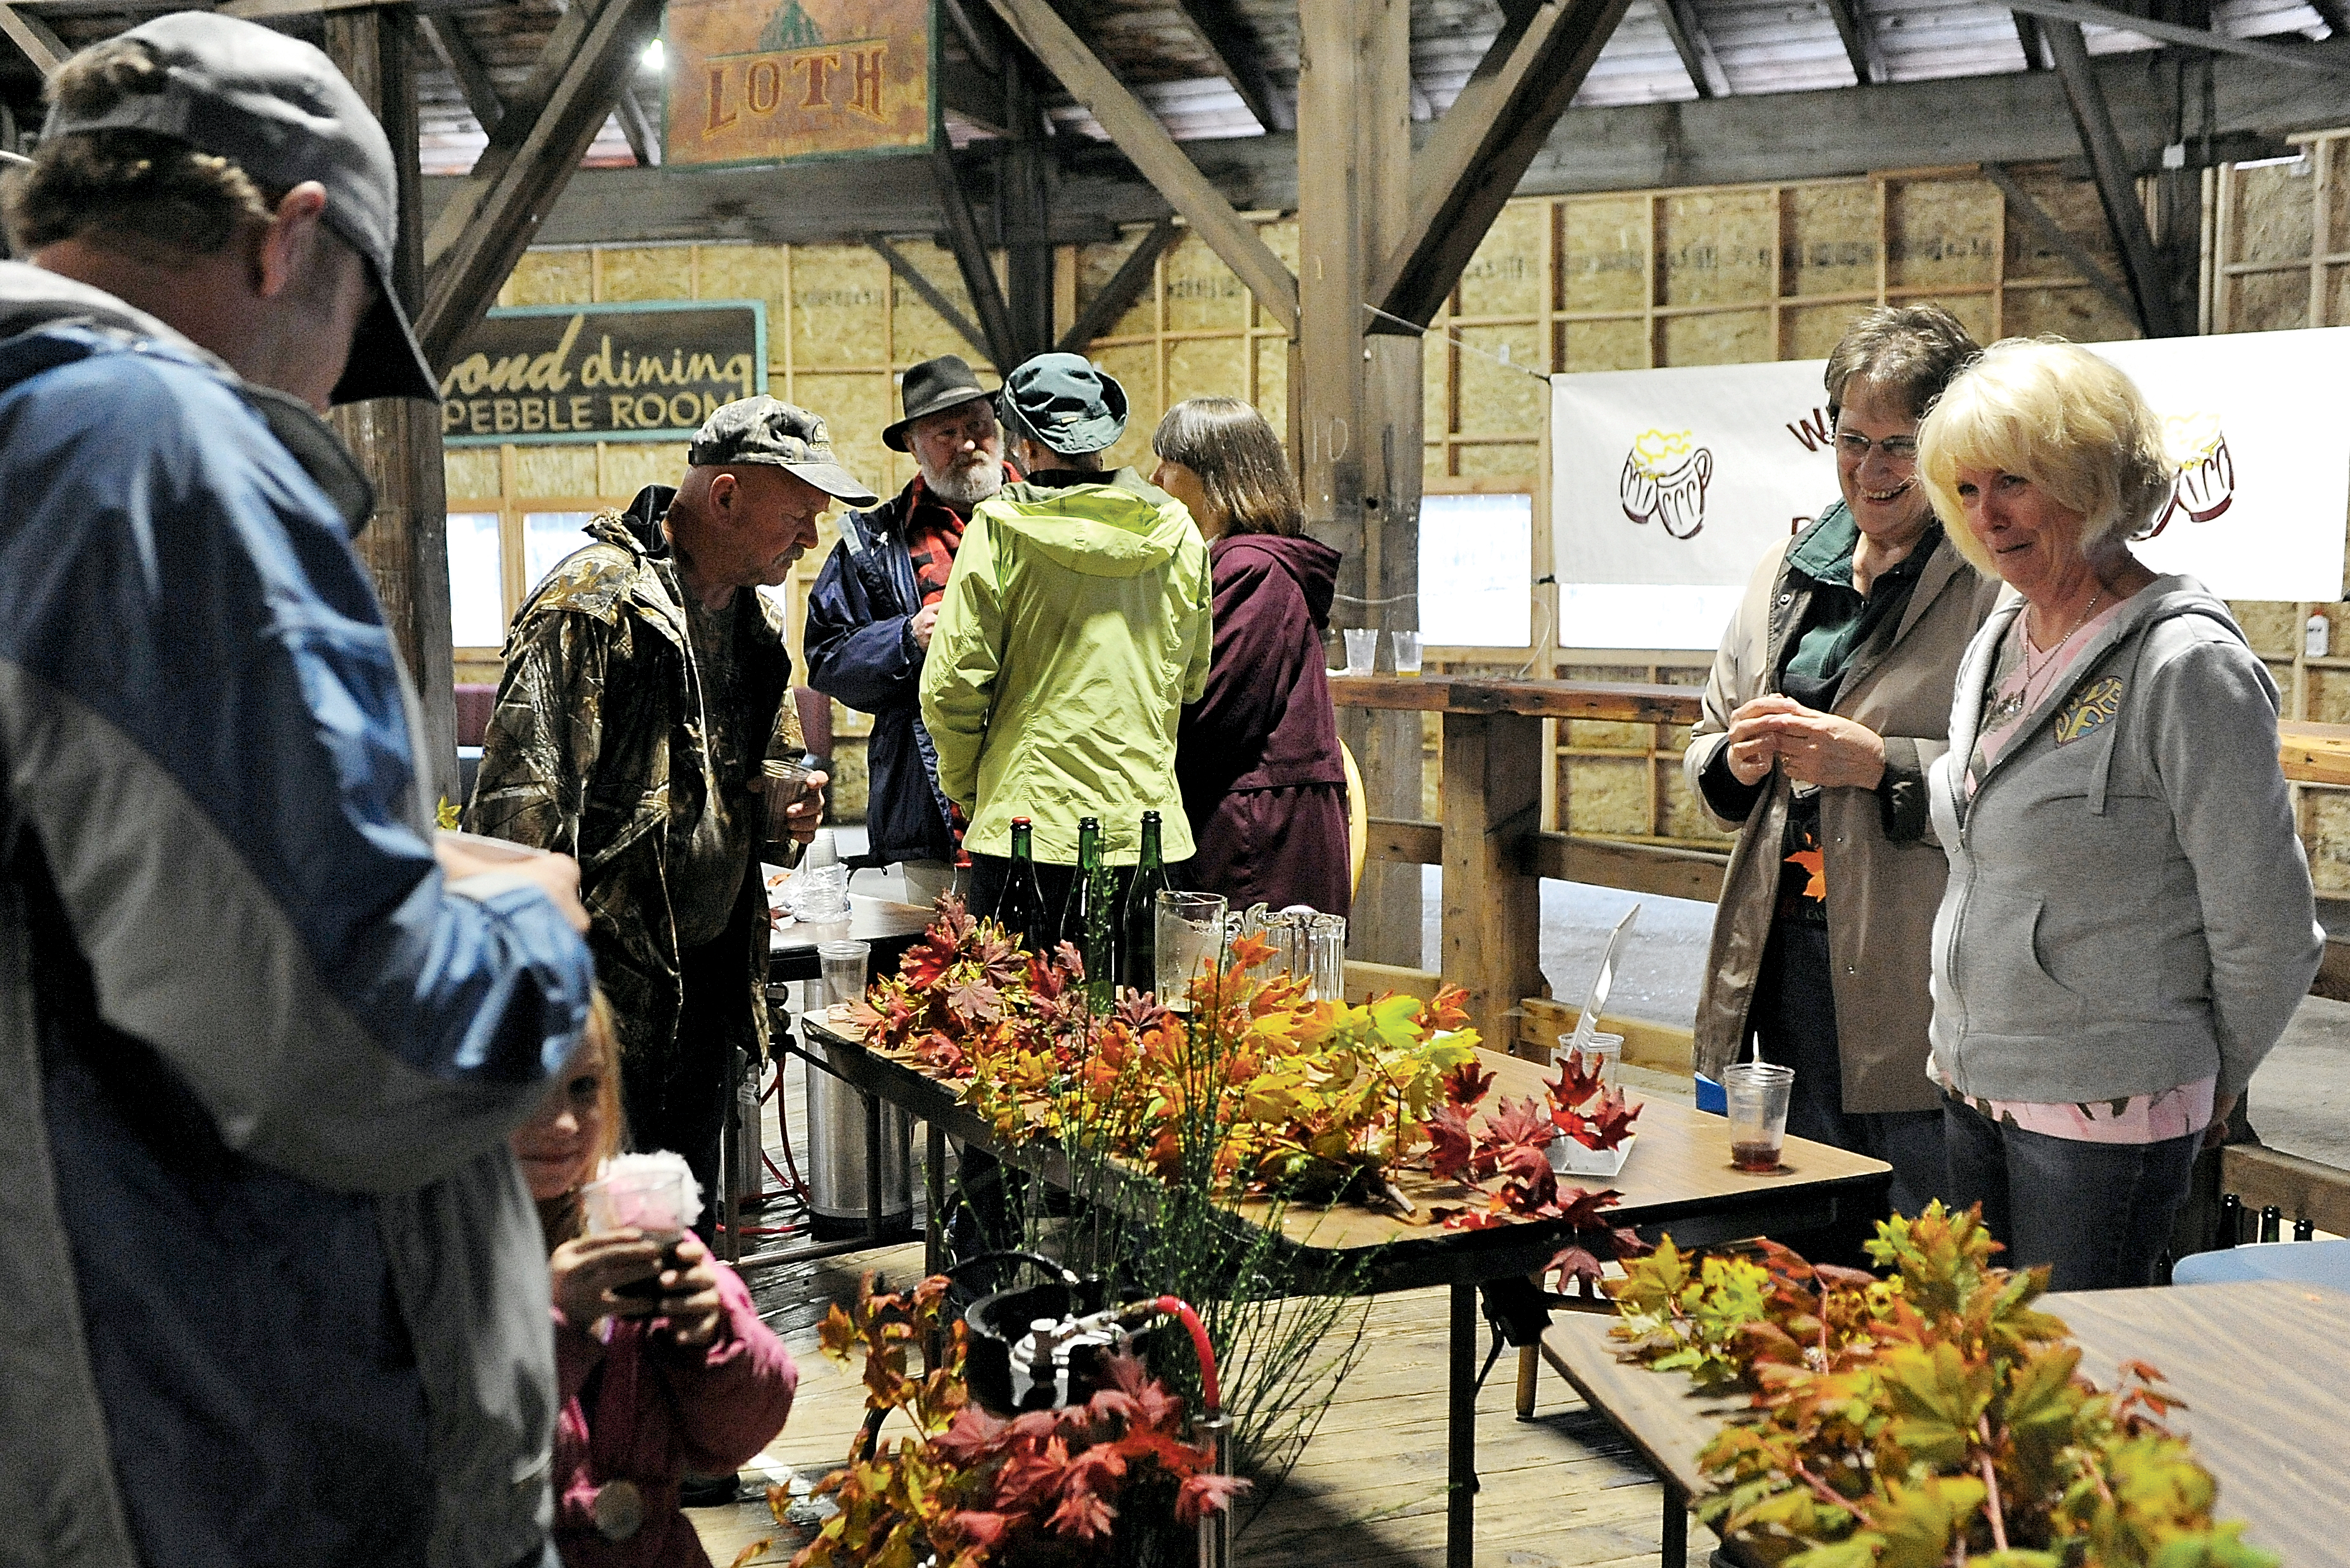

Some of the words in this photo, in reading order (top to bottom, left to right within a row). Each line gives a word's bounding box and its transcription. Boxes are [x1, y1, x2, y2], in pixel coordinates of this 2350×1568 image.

[702, 46, 888, 141] LOTH
[581, 335, 753, 398] dining
[441, 396, 594, 434] PEBBLE
